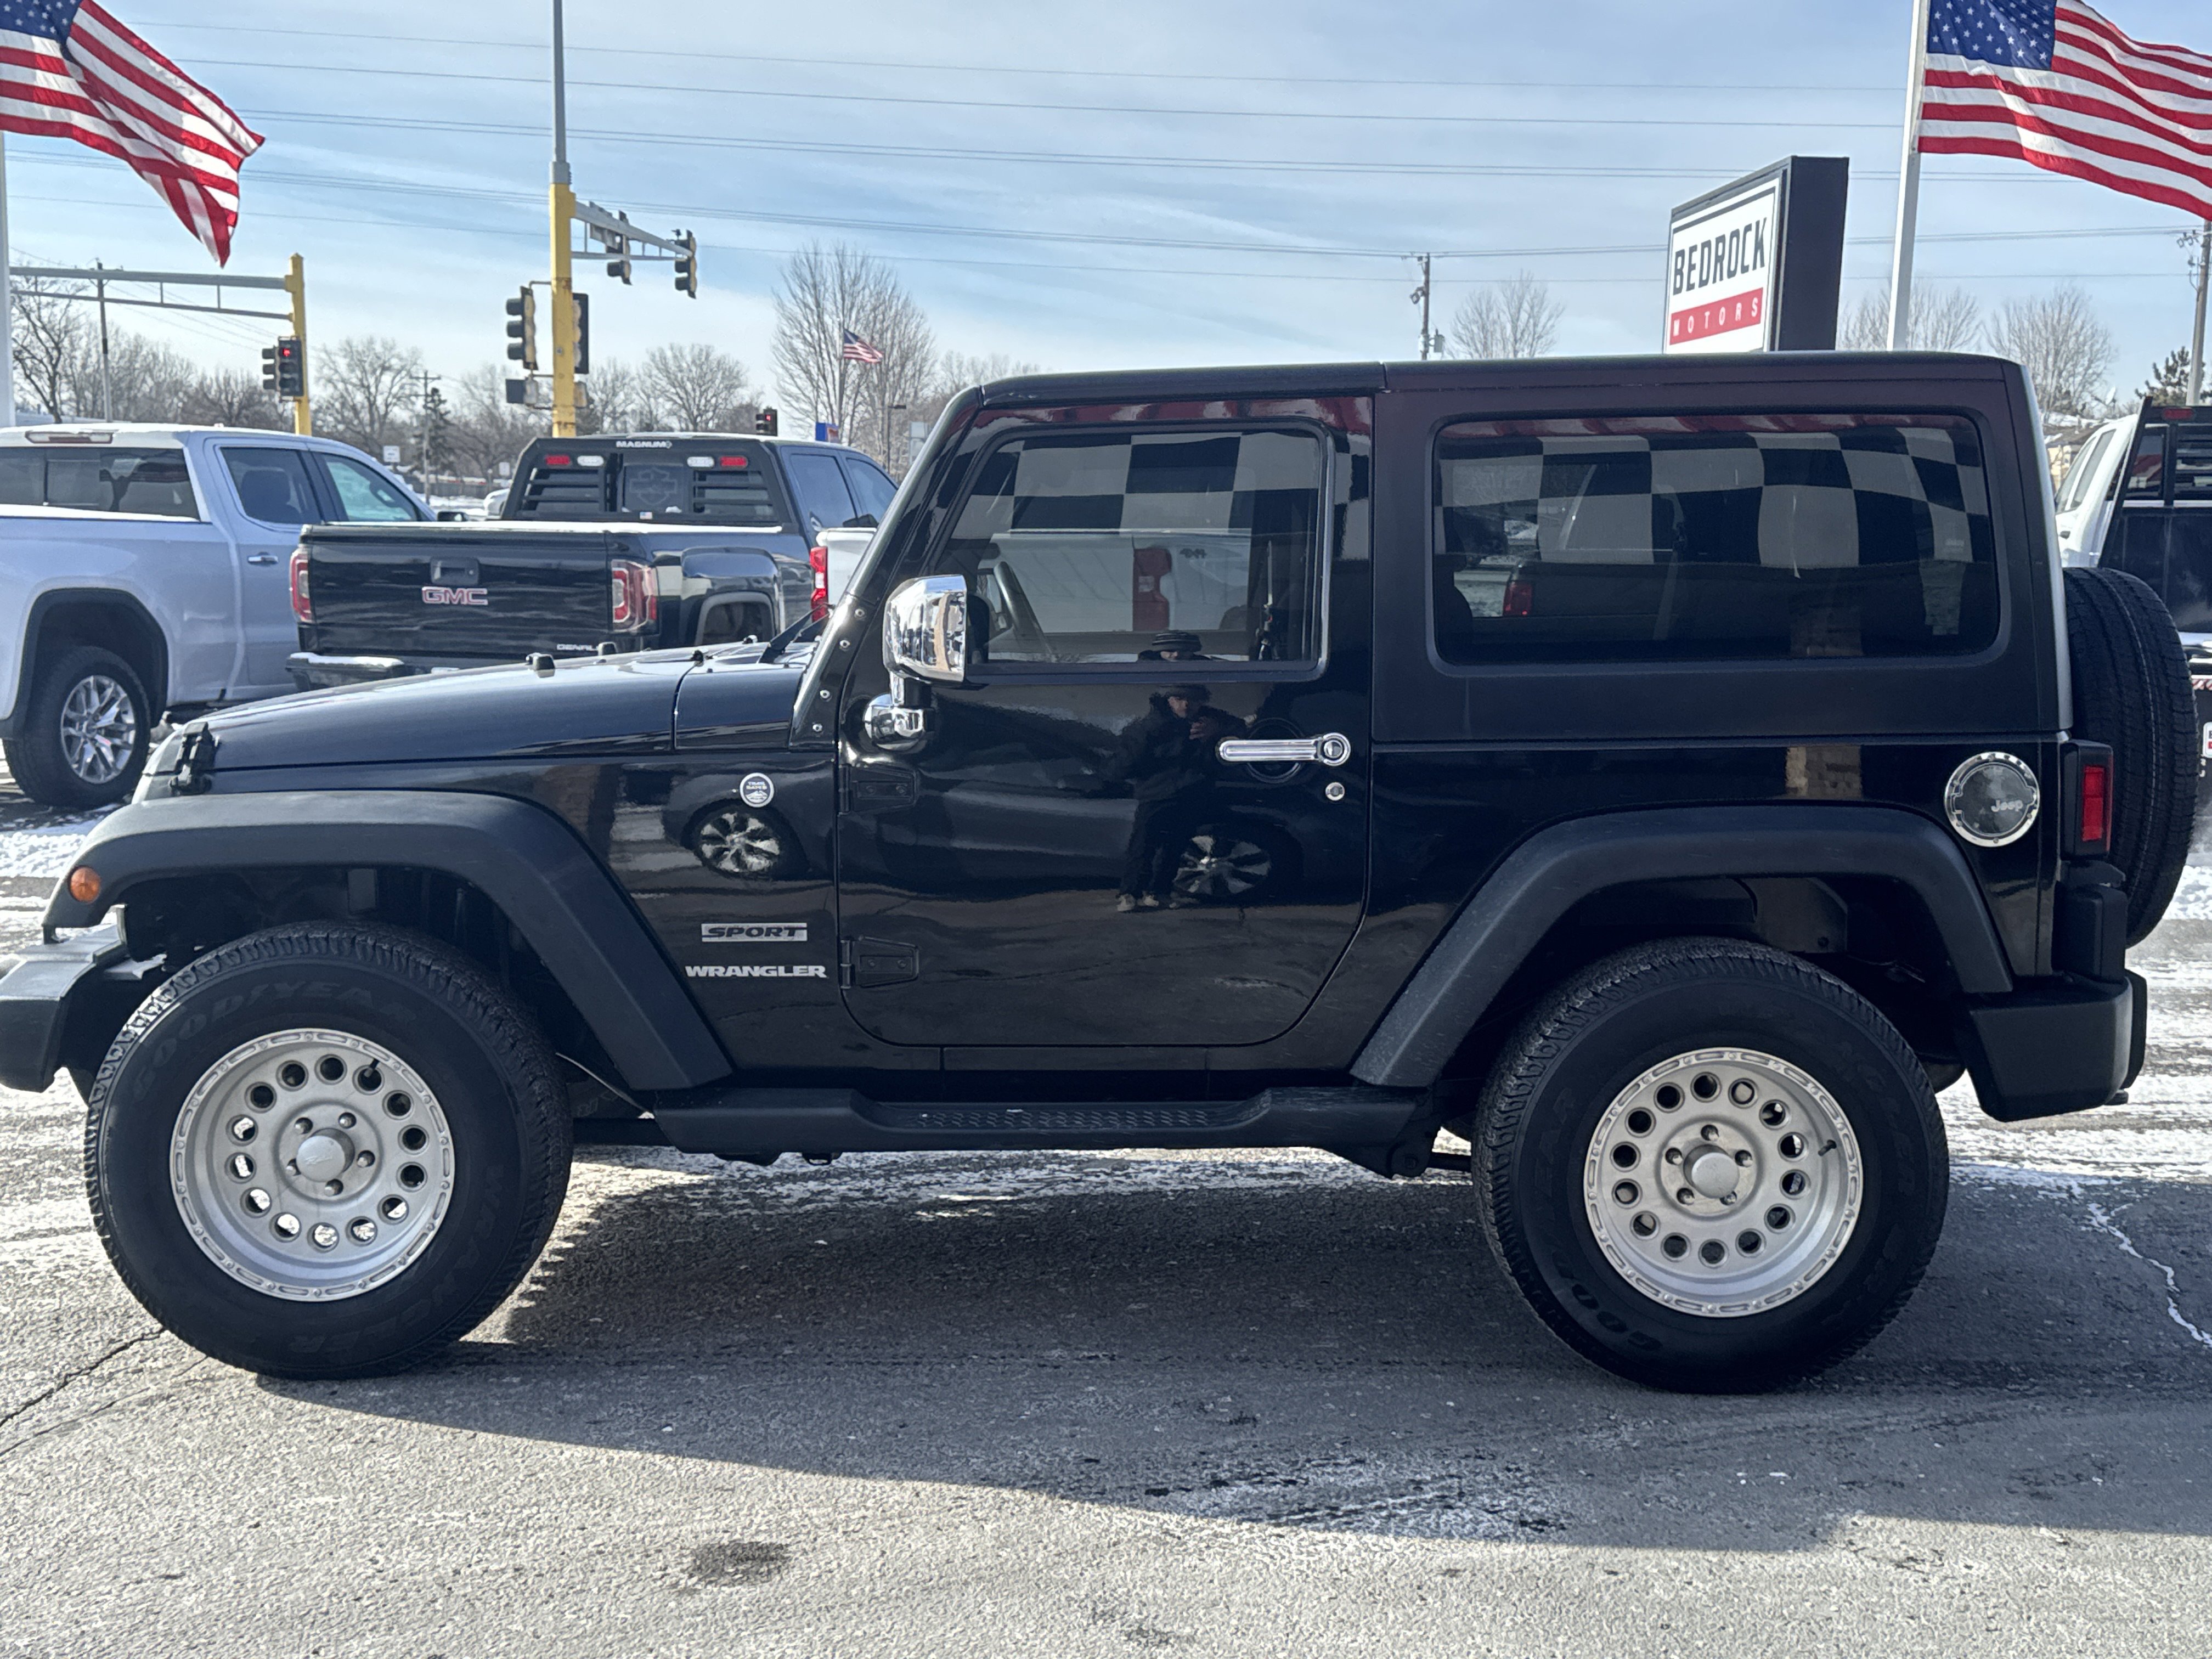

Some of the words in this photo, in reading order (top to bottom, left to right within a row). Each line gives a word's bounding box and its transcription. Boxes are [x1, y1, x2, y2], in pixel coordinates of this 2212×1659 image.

[1673, 217, 1768, 296] BEDROCK
[1672, 297, 1759, 338] MOTORS
[421, 586, 488, 606] GMC
[1991, 799, 2024, 812] Jeep
[704, 926, 802, 939] SPORT
[684, 964, 827, 978] WRANGLER
[132, 980, 417, 1098] GOODYEAR
